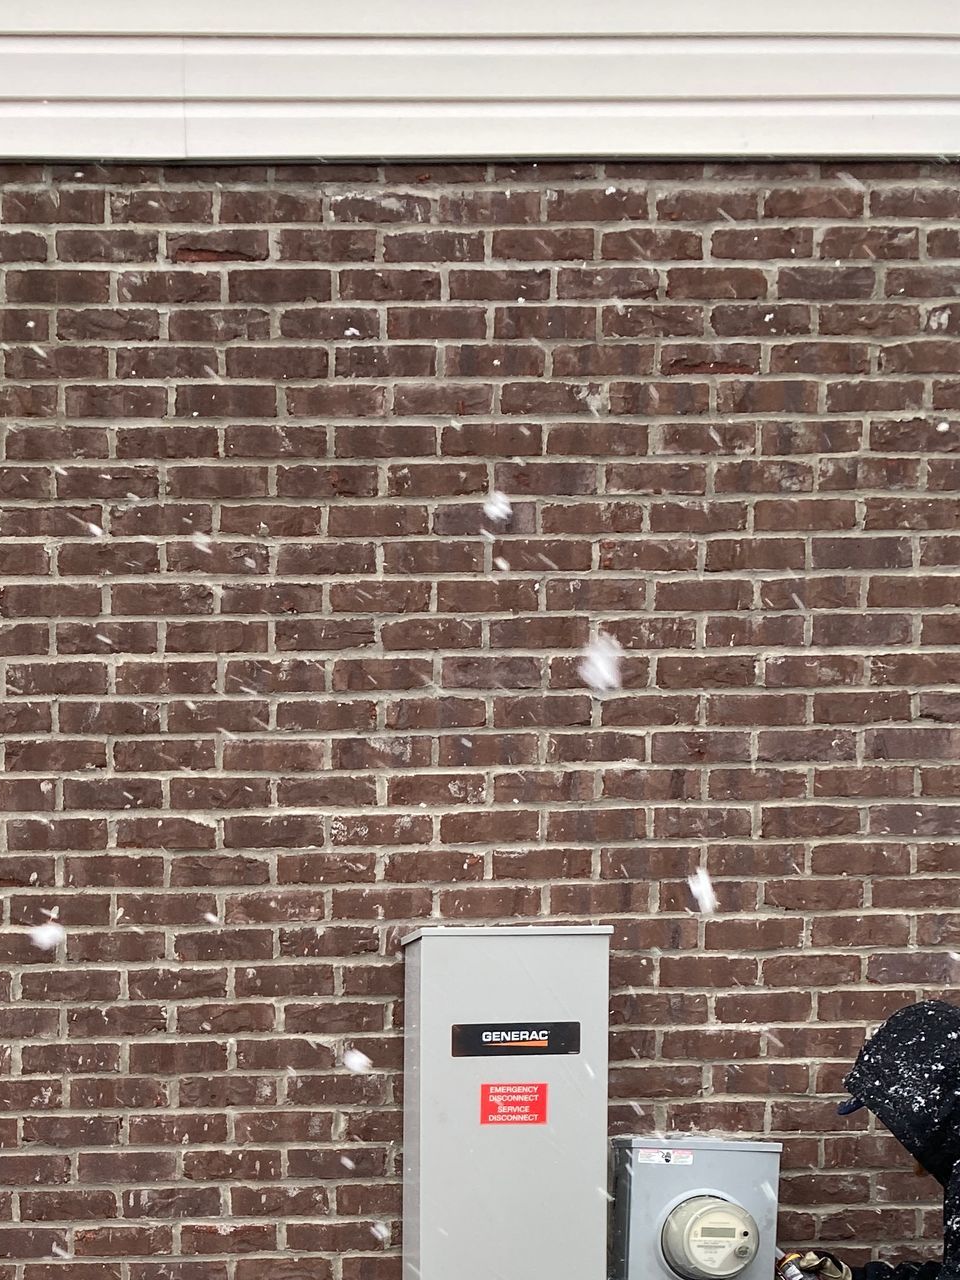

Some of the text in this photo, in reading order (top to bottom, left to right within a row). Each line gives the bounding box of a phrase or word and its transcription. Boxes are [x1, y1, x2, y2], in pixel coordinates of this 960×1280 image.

[482, 1031, 548, 1042] GENERAC
[489, 1086, 539, 1094] EMERGENCY
[488, 1094, 539, 1102] DISCONNECT
[497, 1105, 530, 1113] SERVICE
